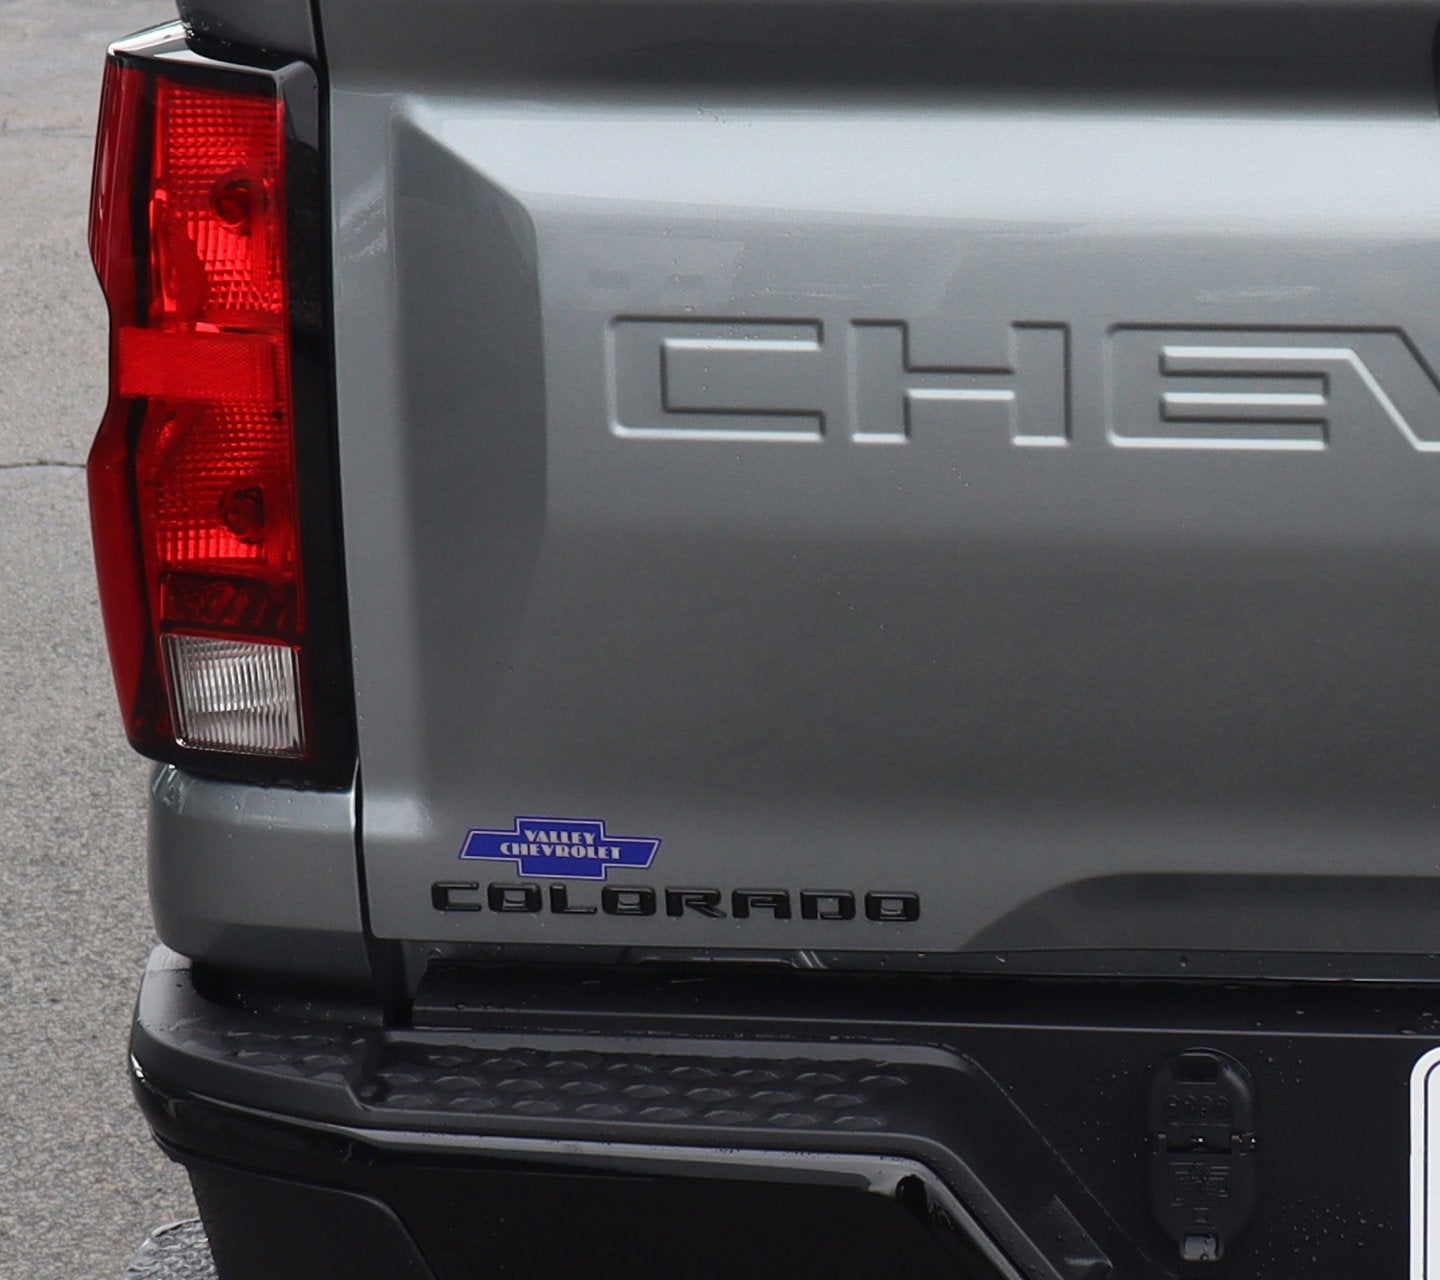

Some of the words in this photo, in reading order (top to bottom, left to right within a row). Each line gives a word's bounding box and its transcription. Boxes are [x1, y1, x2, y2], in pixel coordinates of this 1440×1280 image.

[523, 829, 596, 845] VALLEY
[499, 842, 620, 860] CHEVROLET
[431, 881, 921, 922] COLORADO
